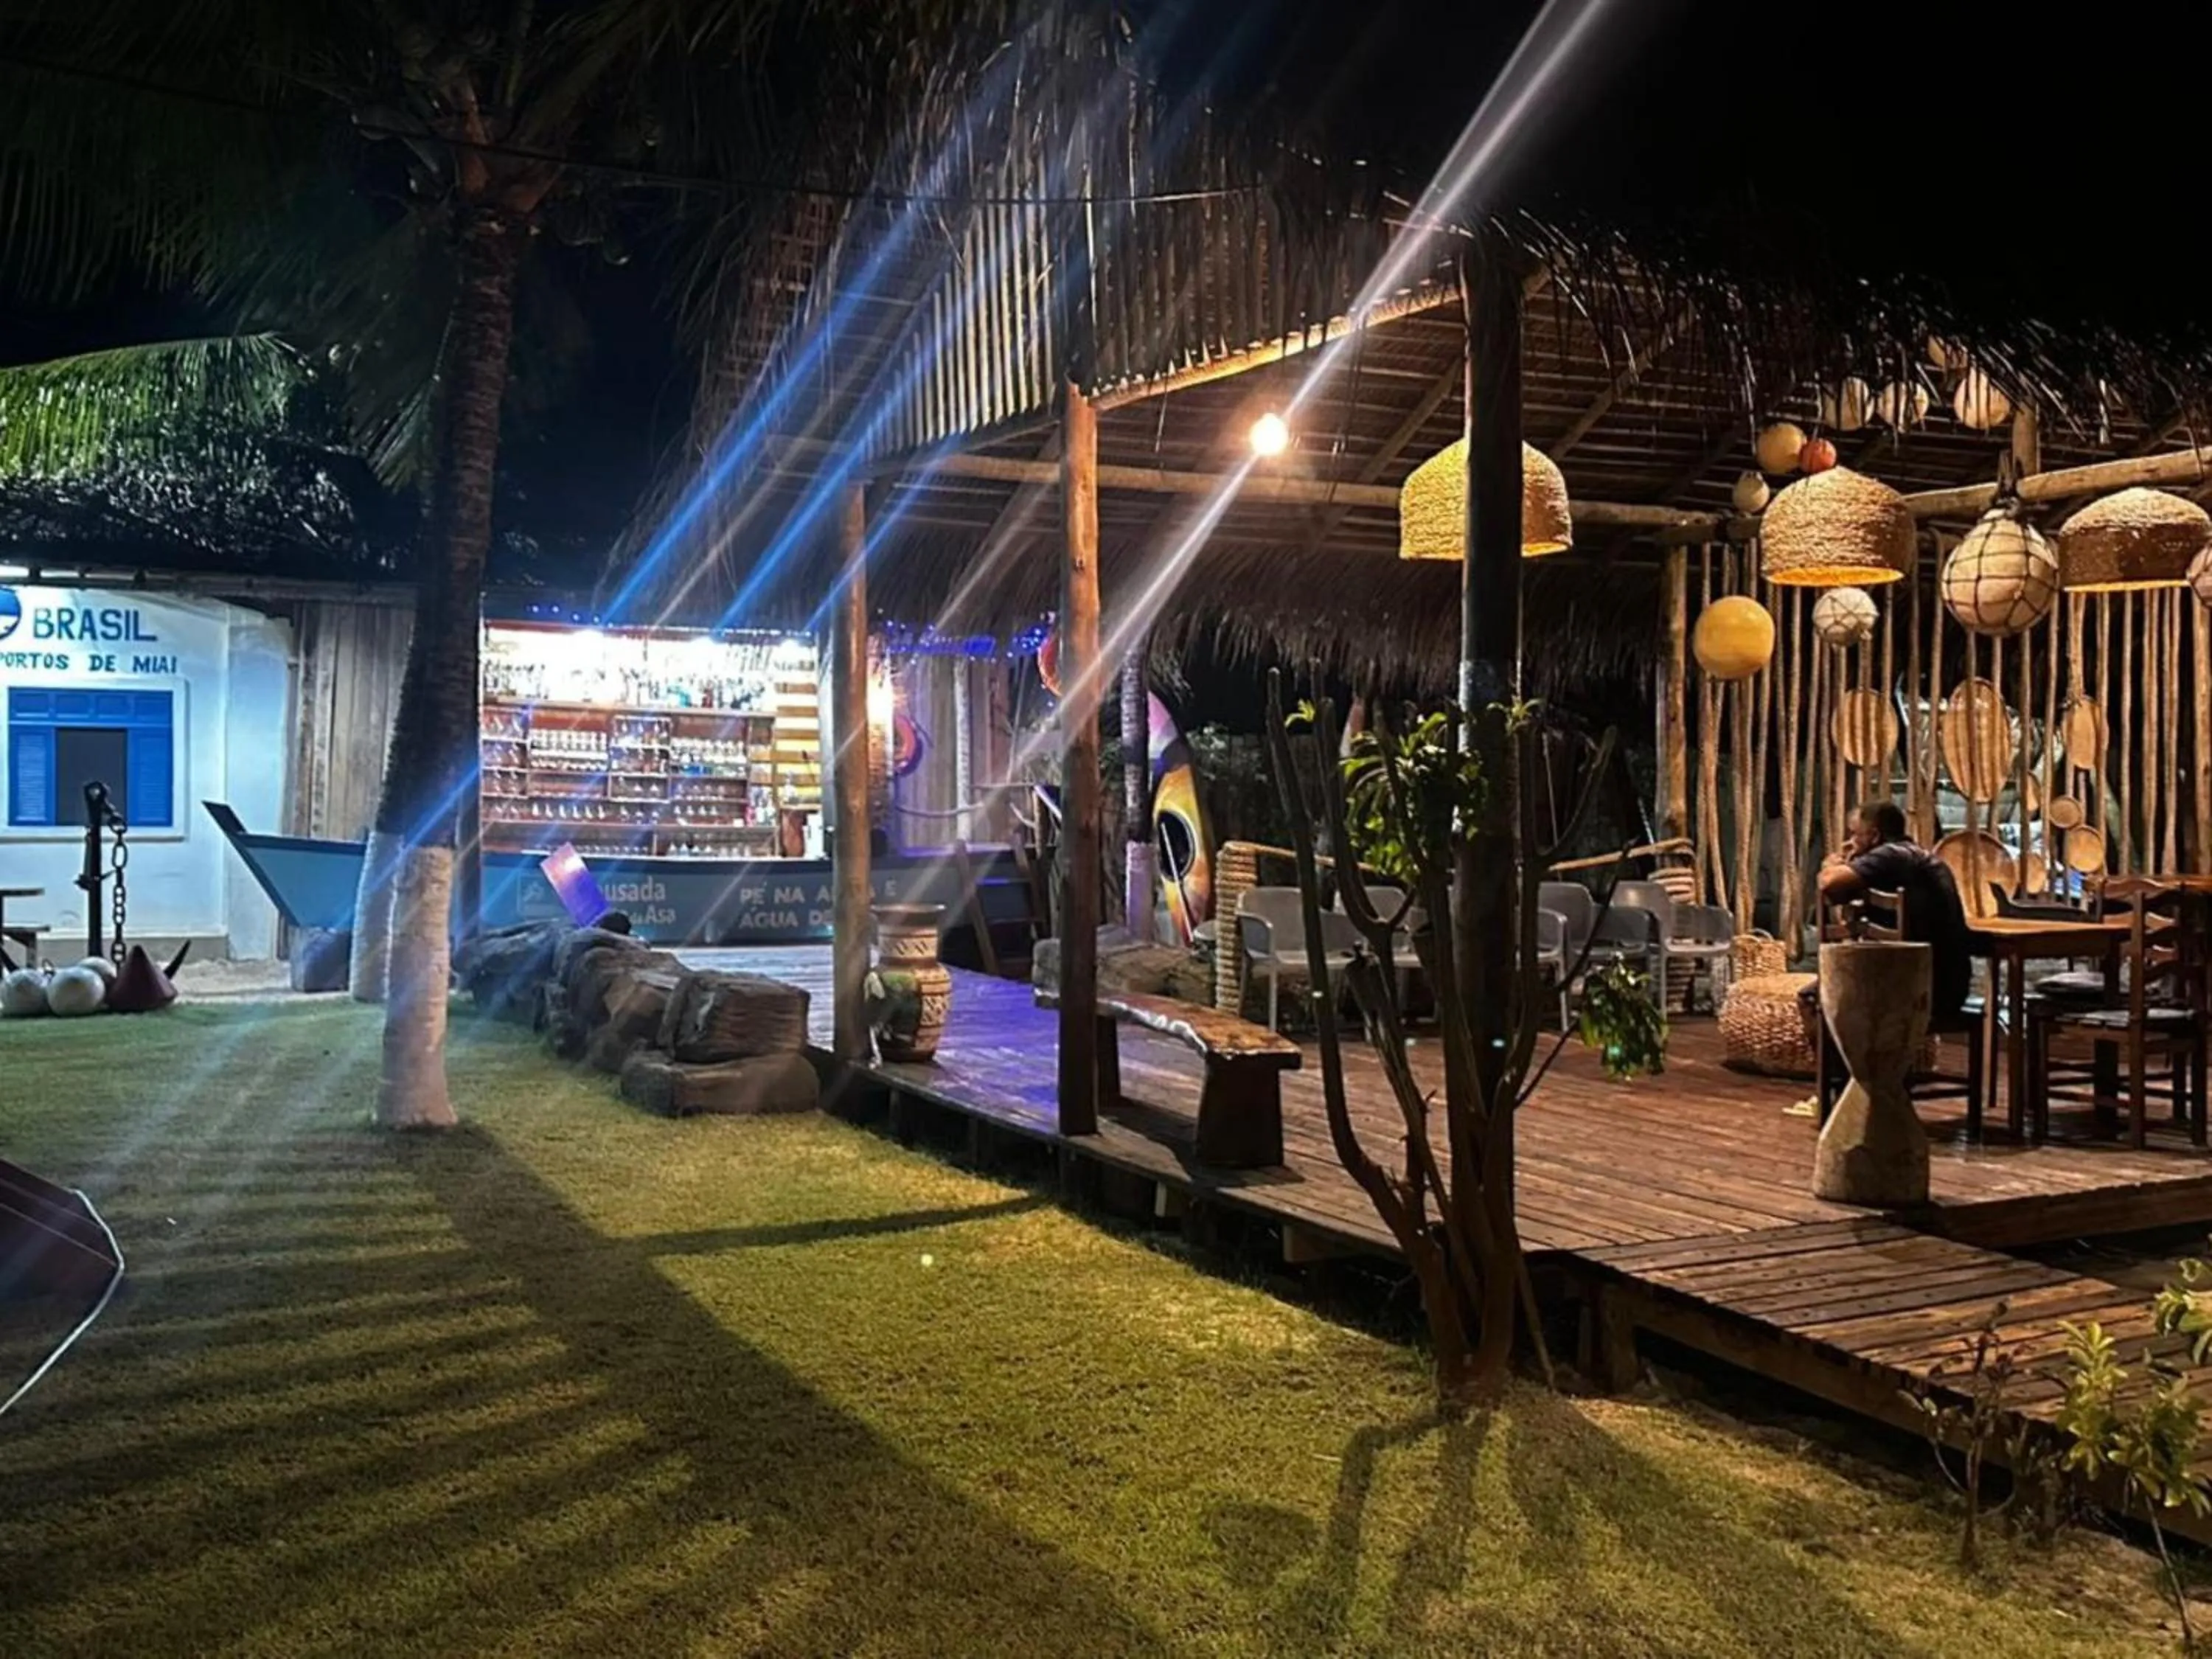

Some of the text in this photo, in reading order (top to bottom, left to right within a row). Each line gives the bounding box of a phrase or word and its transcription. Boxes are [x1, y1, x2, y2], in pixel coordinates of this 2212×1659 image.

[32, 607, 158, 641] BRASIL
[88, 654, 116, 672] DE
[775, 886, 805, 903] NA
[740, 905, 799, 928] ÁGUA
